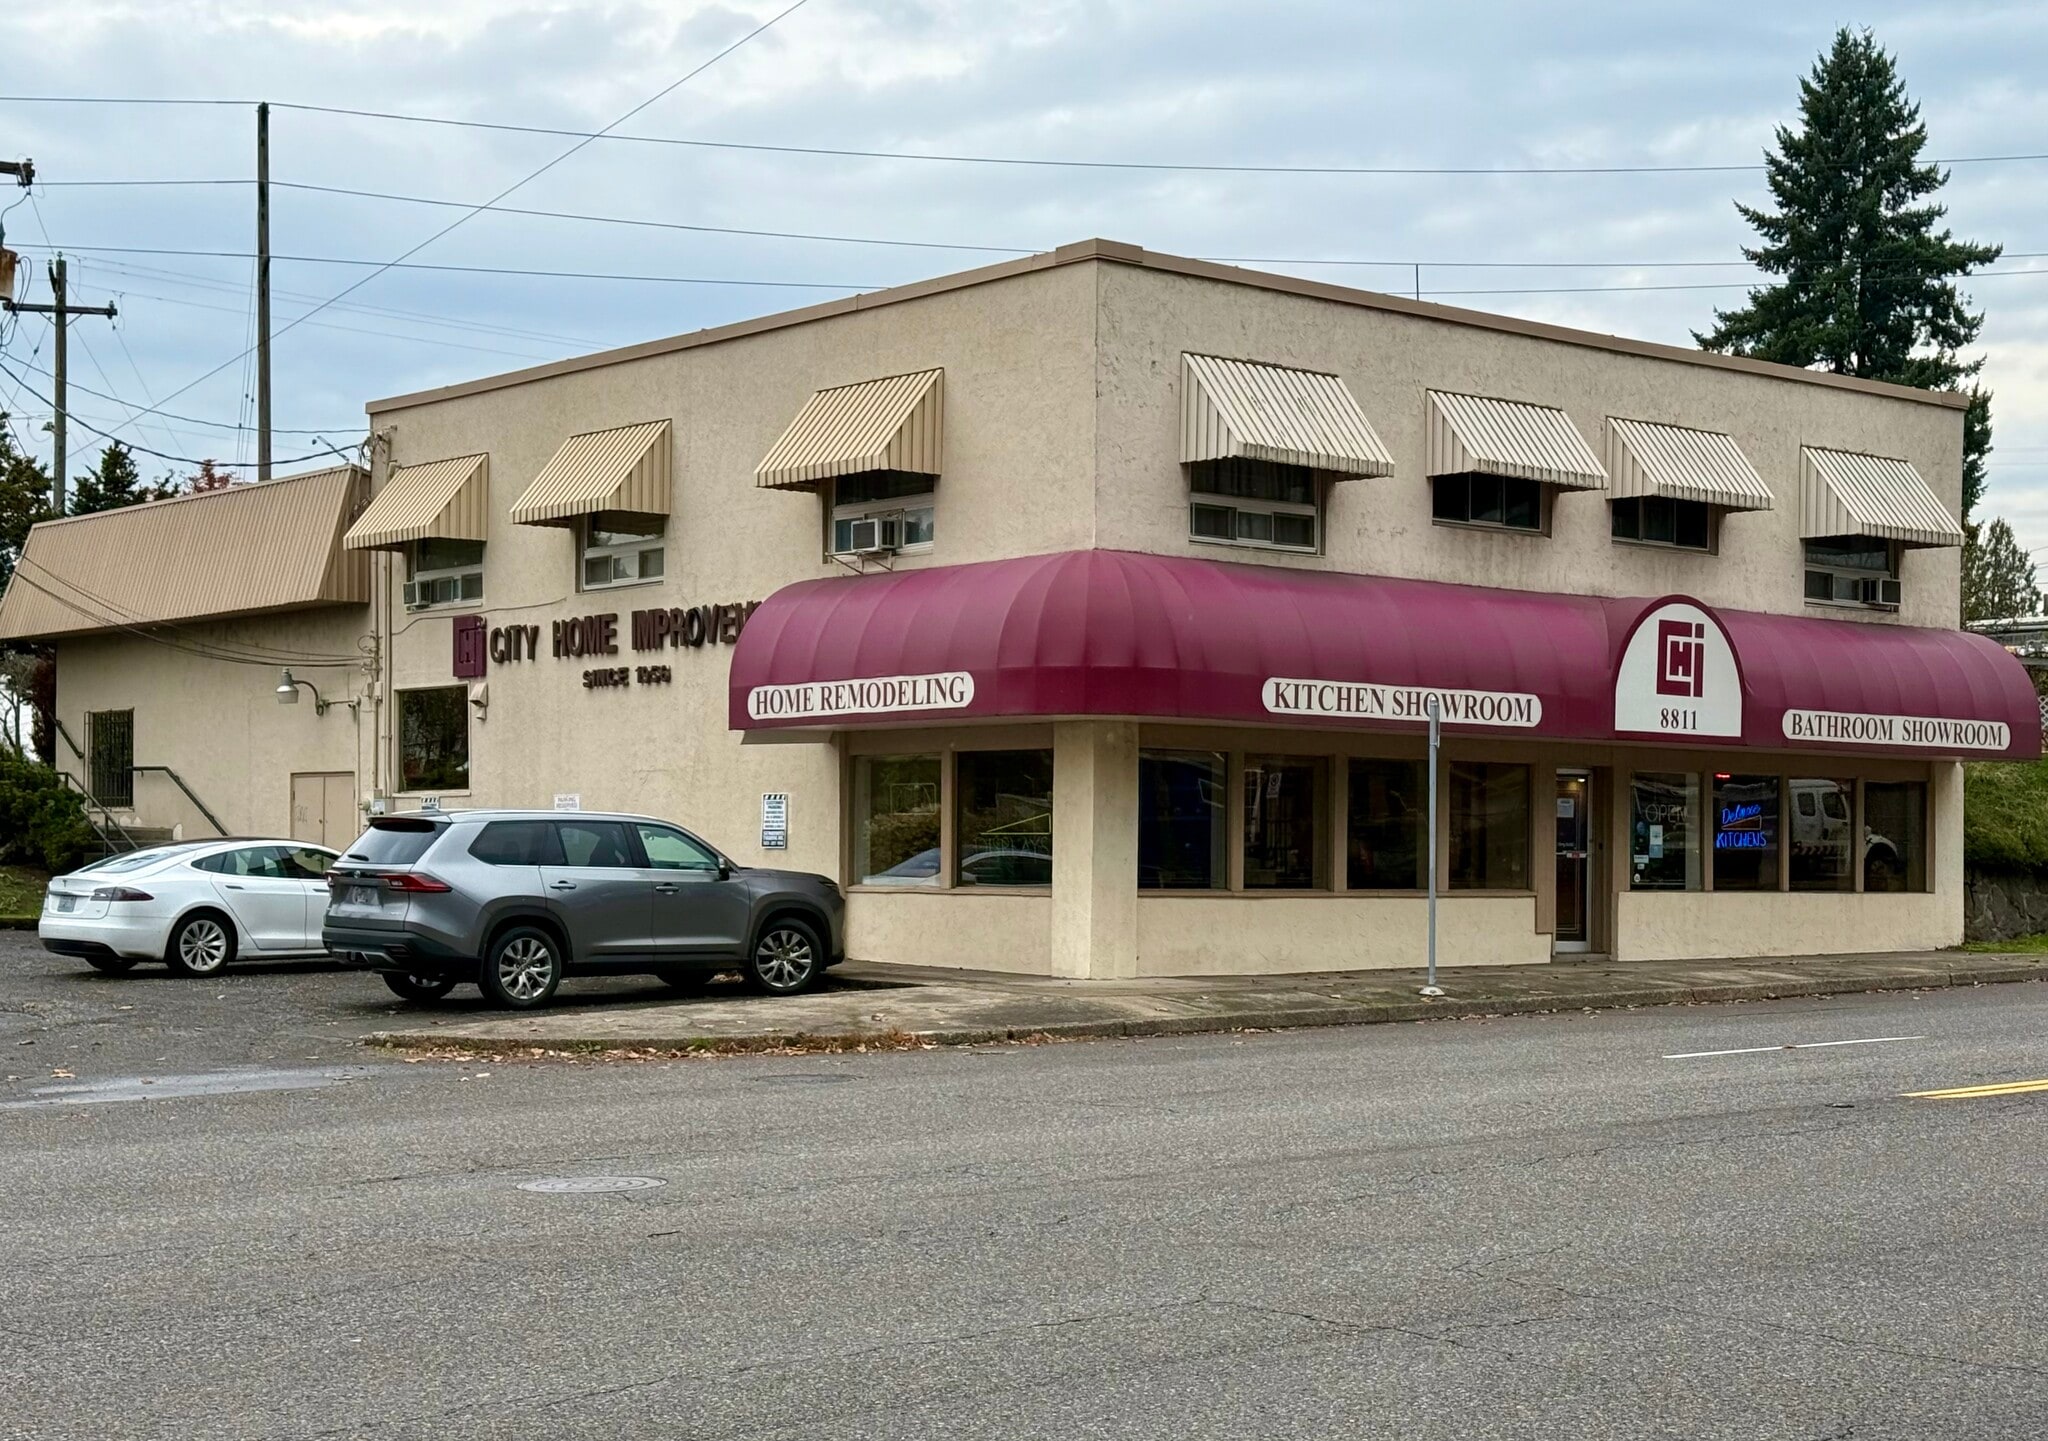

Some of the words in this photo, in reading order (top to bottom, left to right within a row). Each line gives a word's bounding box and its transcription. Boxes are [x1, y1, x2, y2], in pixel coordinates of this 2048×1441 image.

[490, 624, 540, 664] CITY
[552, 612, 618, 658] HOME
[582, 667, 630, 689] SINCE
[755, 686, 814, 715] HOME
[820, 675, 965, 711] REMODELING
[1273, 681, 1386, 714] KITCHEN
[1392, 690, 1533, 723] SHOWROOM
[1660, 707, 1697, 730] 8811
[1791, 713, 1893, 741] BATHROOM
[1902, 719, 2003, 746] SHOWROOM
[1645, 804, 1688, 822] OPEN
[1716, 832, 1767, 848] KITCHENS
